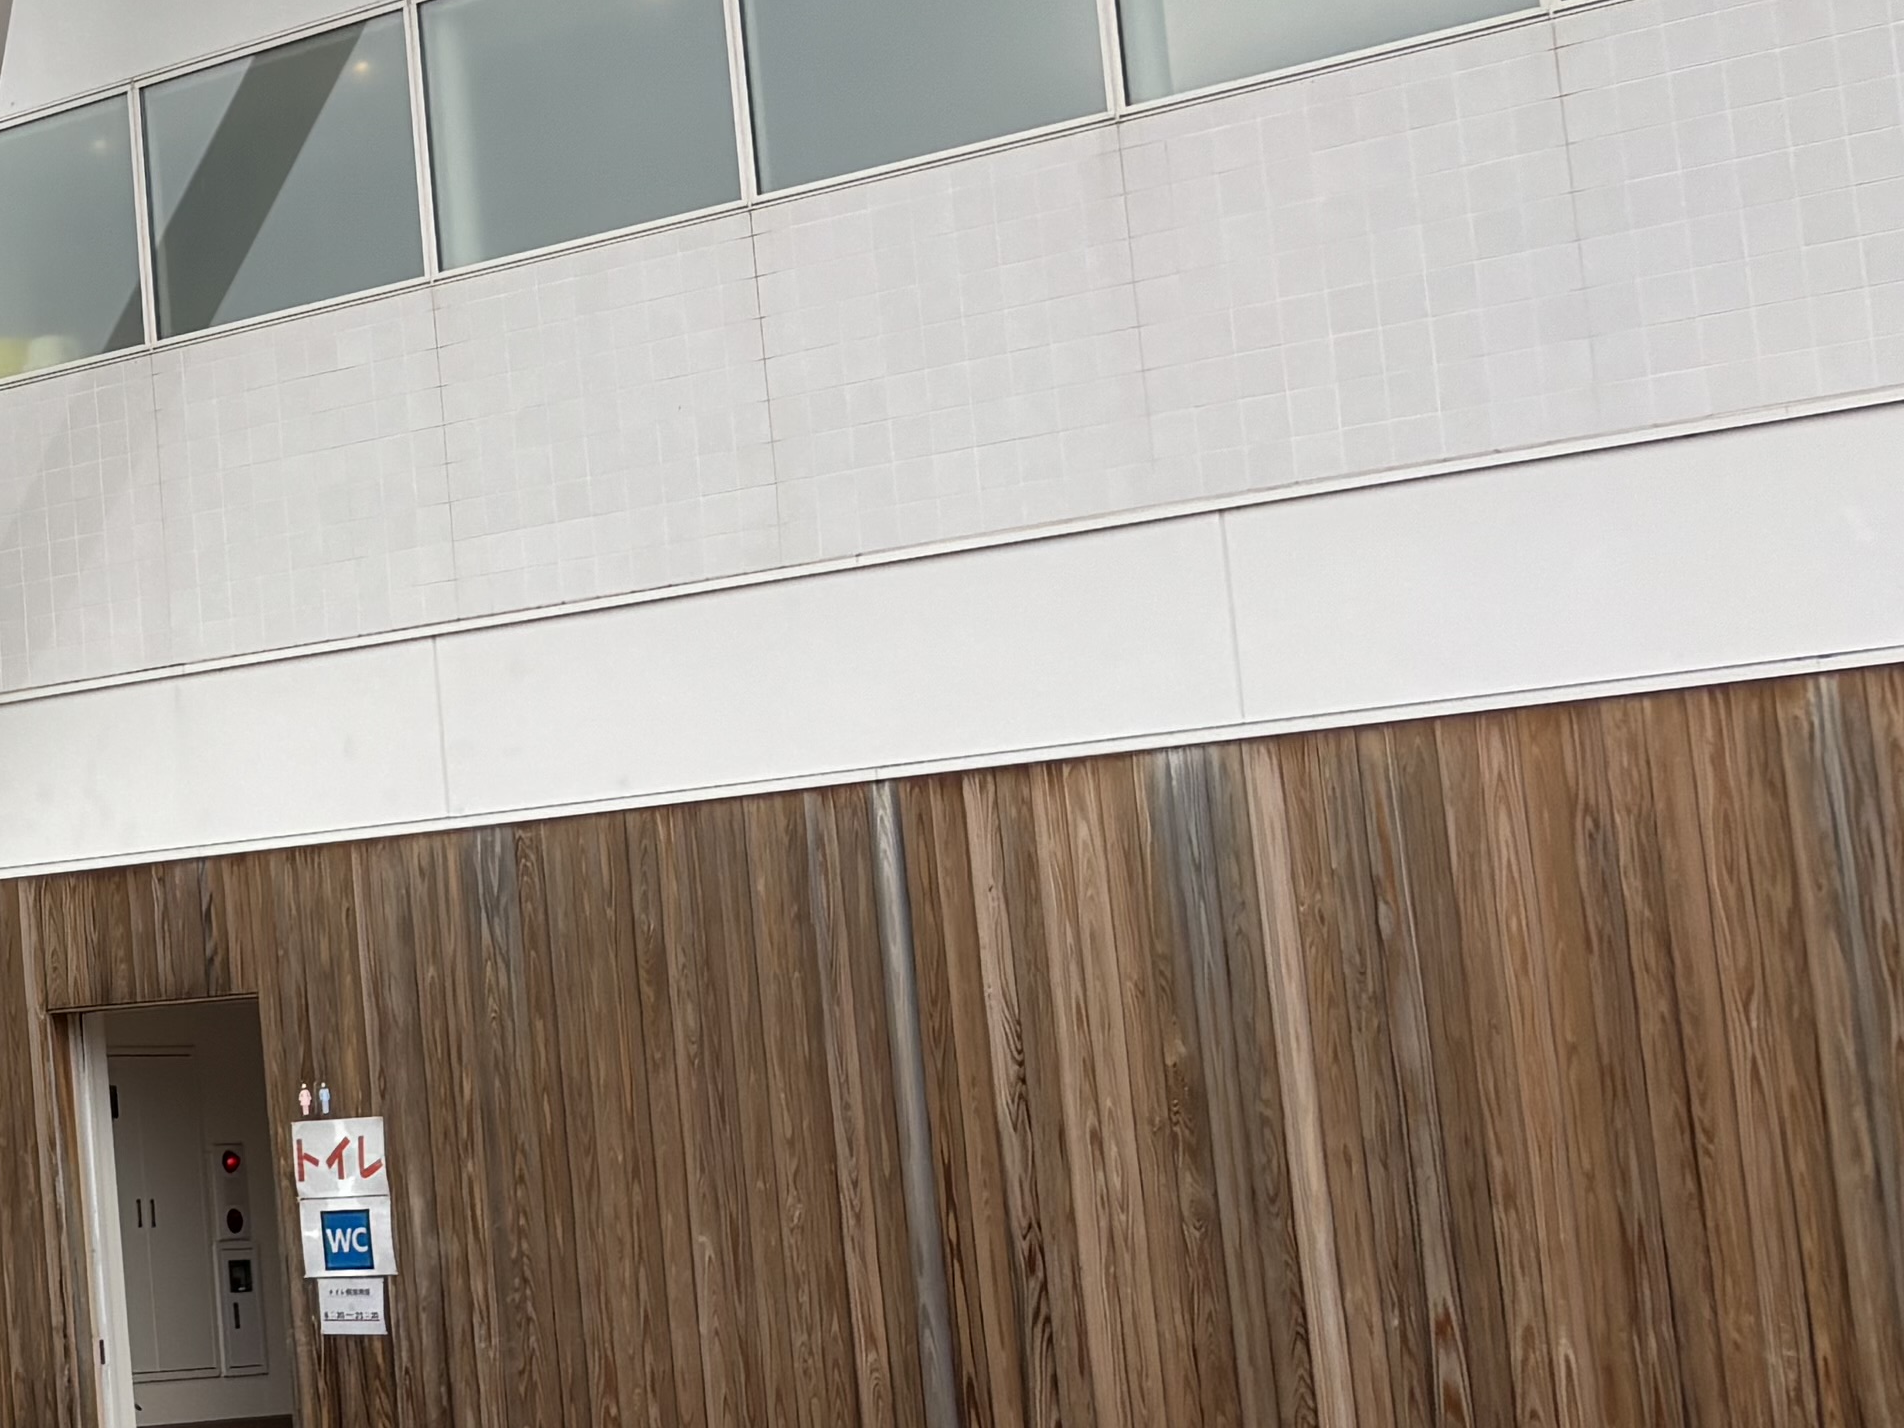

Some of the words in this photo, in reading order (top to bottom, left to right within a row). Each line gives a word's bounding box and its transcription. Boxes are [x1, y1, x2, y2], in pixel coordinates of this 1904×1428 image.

[295, 1135, 384, 1182] トイレ
[325, 1227, 369, 1254] WC
